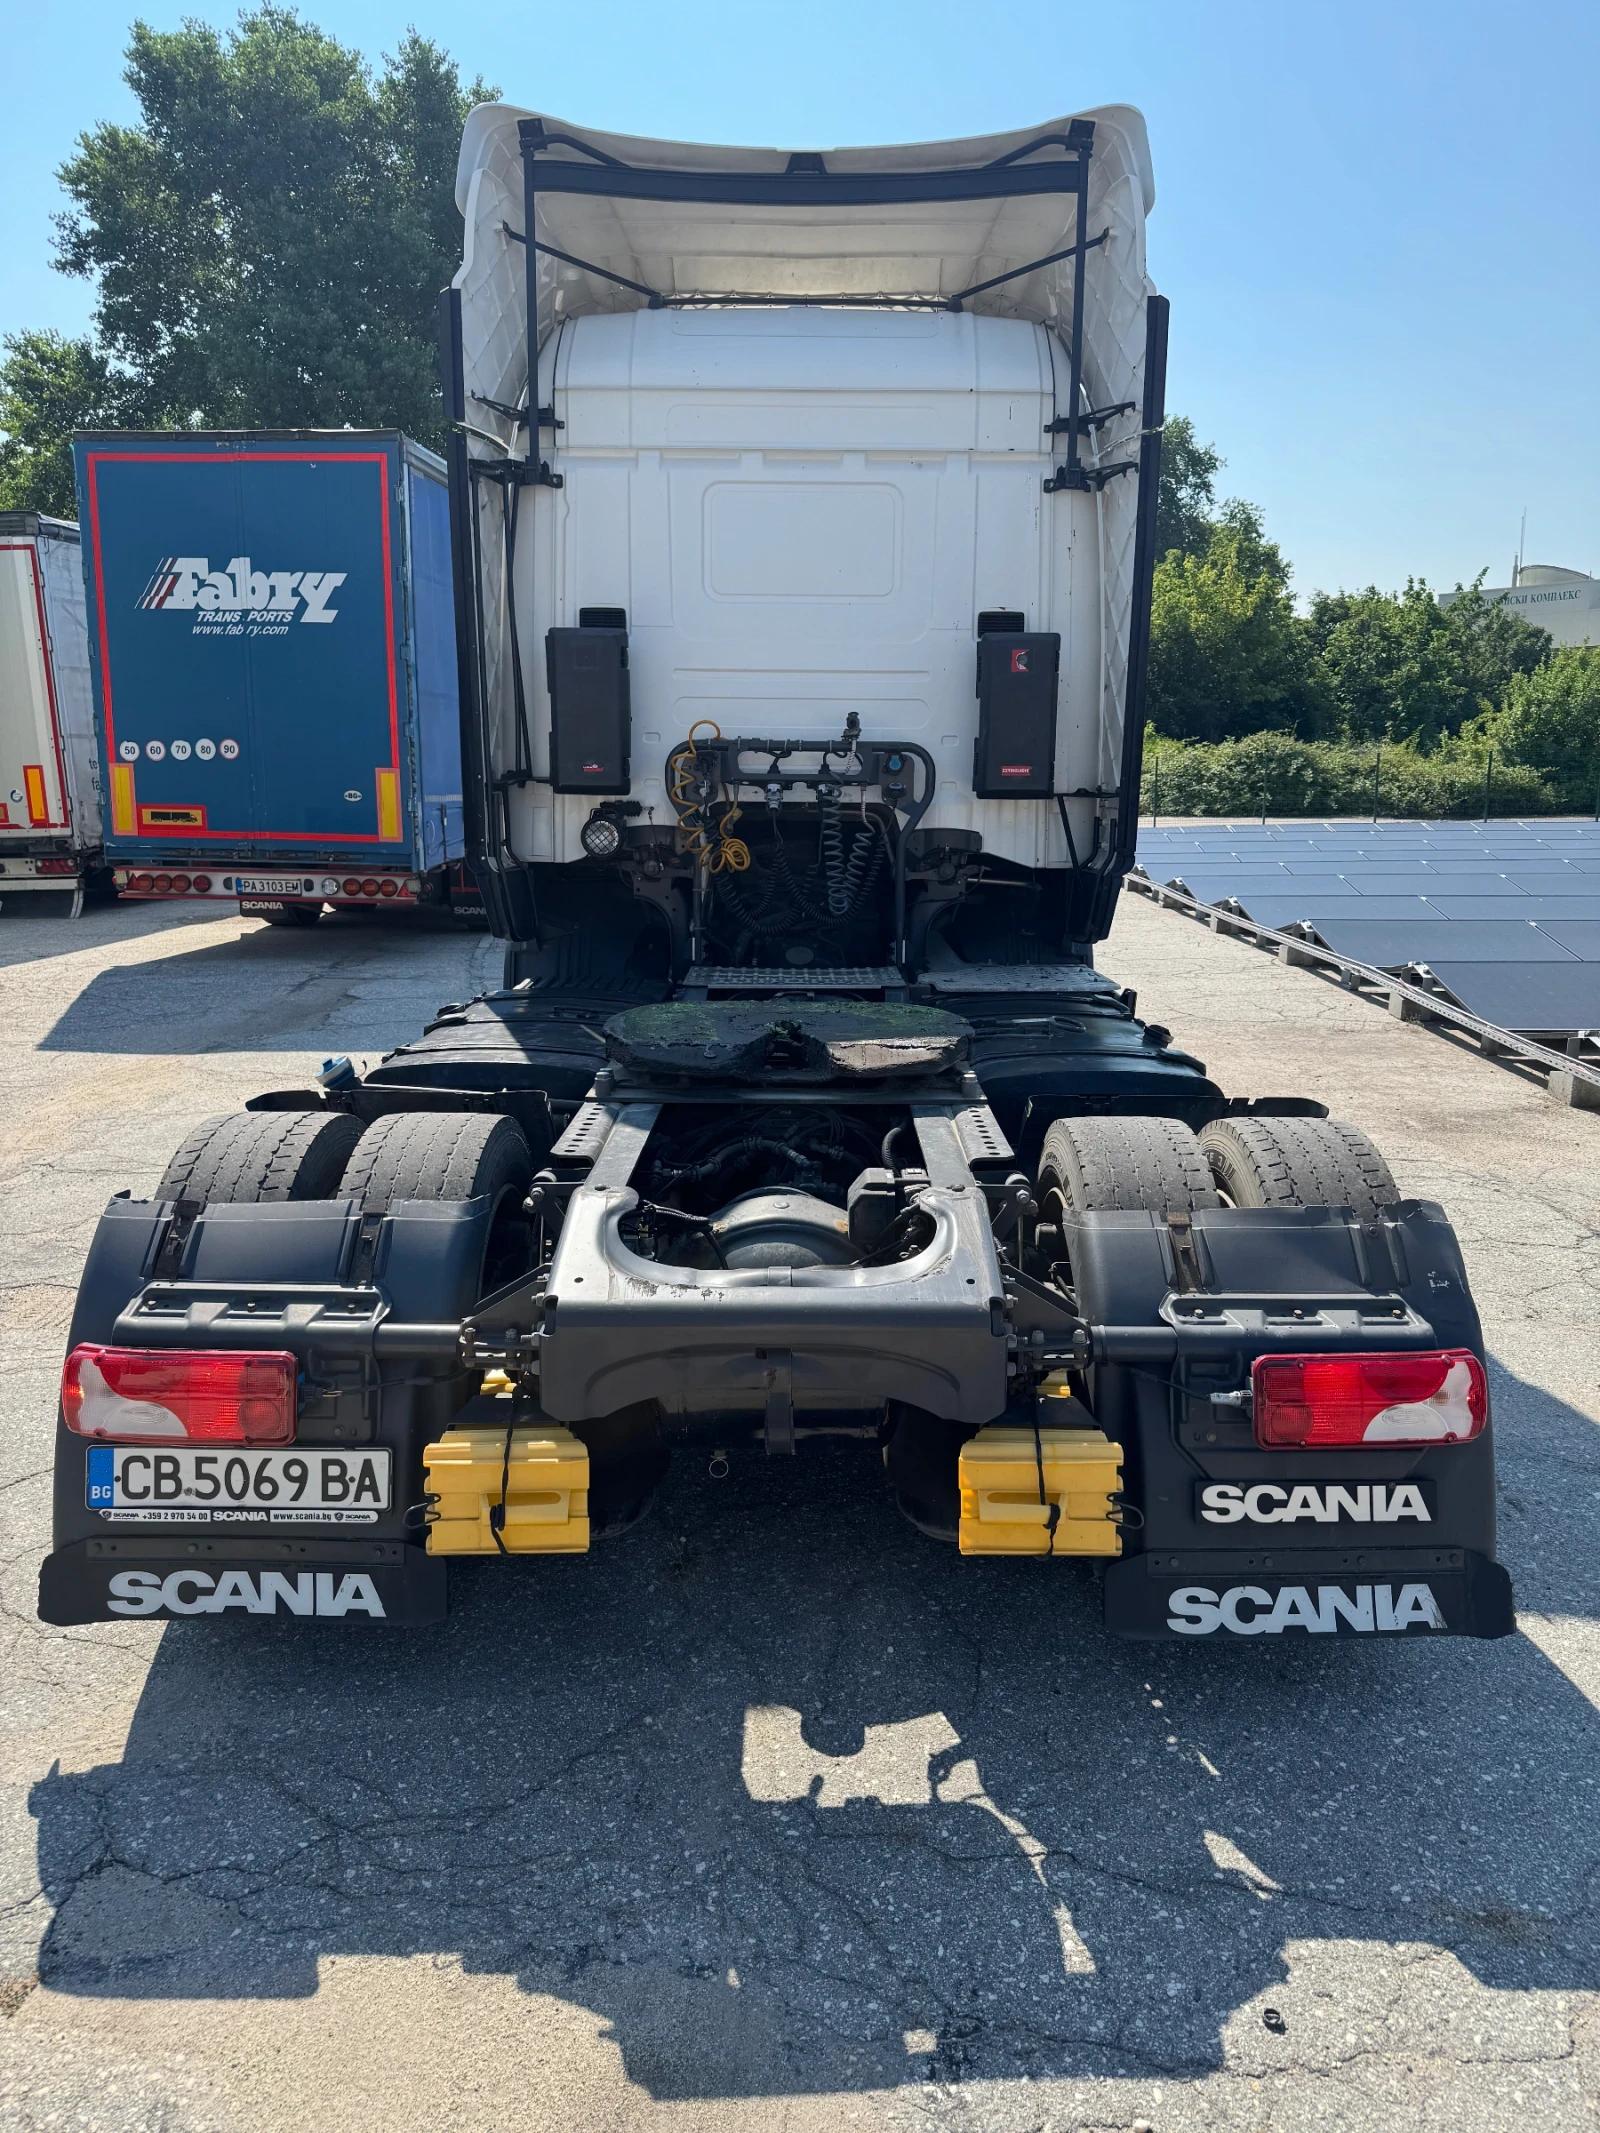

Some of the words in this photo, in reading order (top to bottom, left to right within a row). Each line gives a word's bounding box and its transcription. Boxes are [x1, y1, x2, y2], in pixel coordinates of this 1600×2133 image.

[162, 557, 348, 623] Fabry
[1530, 589, 1581, 604] КОМПЛЕКС
[124, 746, 136, 755] 50
[150, 746, 162, 755] 60
[175, 745, 187, 754] 70
[200, 745, 211, 755] 80
[223, 745, 235, 754] 90
[243, 881, 257, 892] PA
[259, 881, 284, 892] 3103
[242, 901, 284, 909] SCANIA
[454, 906, 487, 915] SCAN
[121, 1455, 183, 1500] CB
[194, 1456, 309, 1502] 5069
[321, 1458, 382, 1503] BA
[91, 1485, 112, 1499] BG
[1201, 1484, 1431, 1523] SCANIA
[142, 1511, 162, 1520] +359
[163, 1512, 169, 1520] 2
[170, 1512, 185, 1520] 970
[187, 1512, 196, 1520] 54
[198, 1512, 208, 1521] 00
[212, 1511, 268, 1522] SCANIA
[273, 1512, 332, 1521] www.scania.bg
[106, 1570, 388, 1618] SCANIA
[1166, 1583, 1448, 1635] SCANIA
